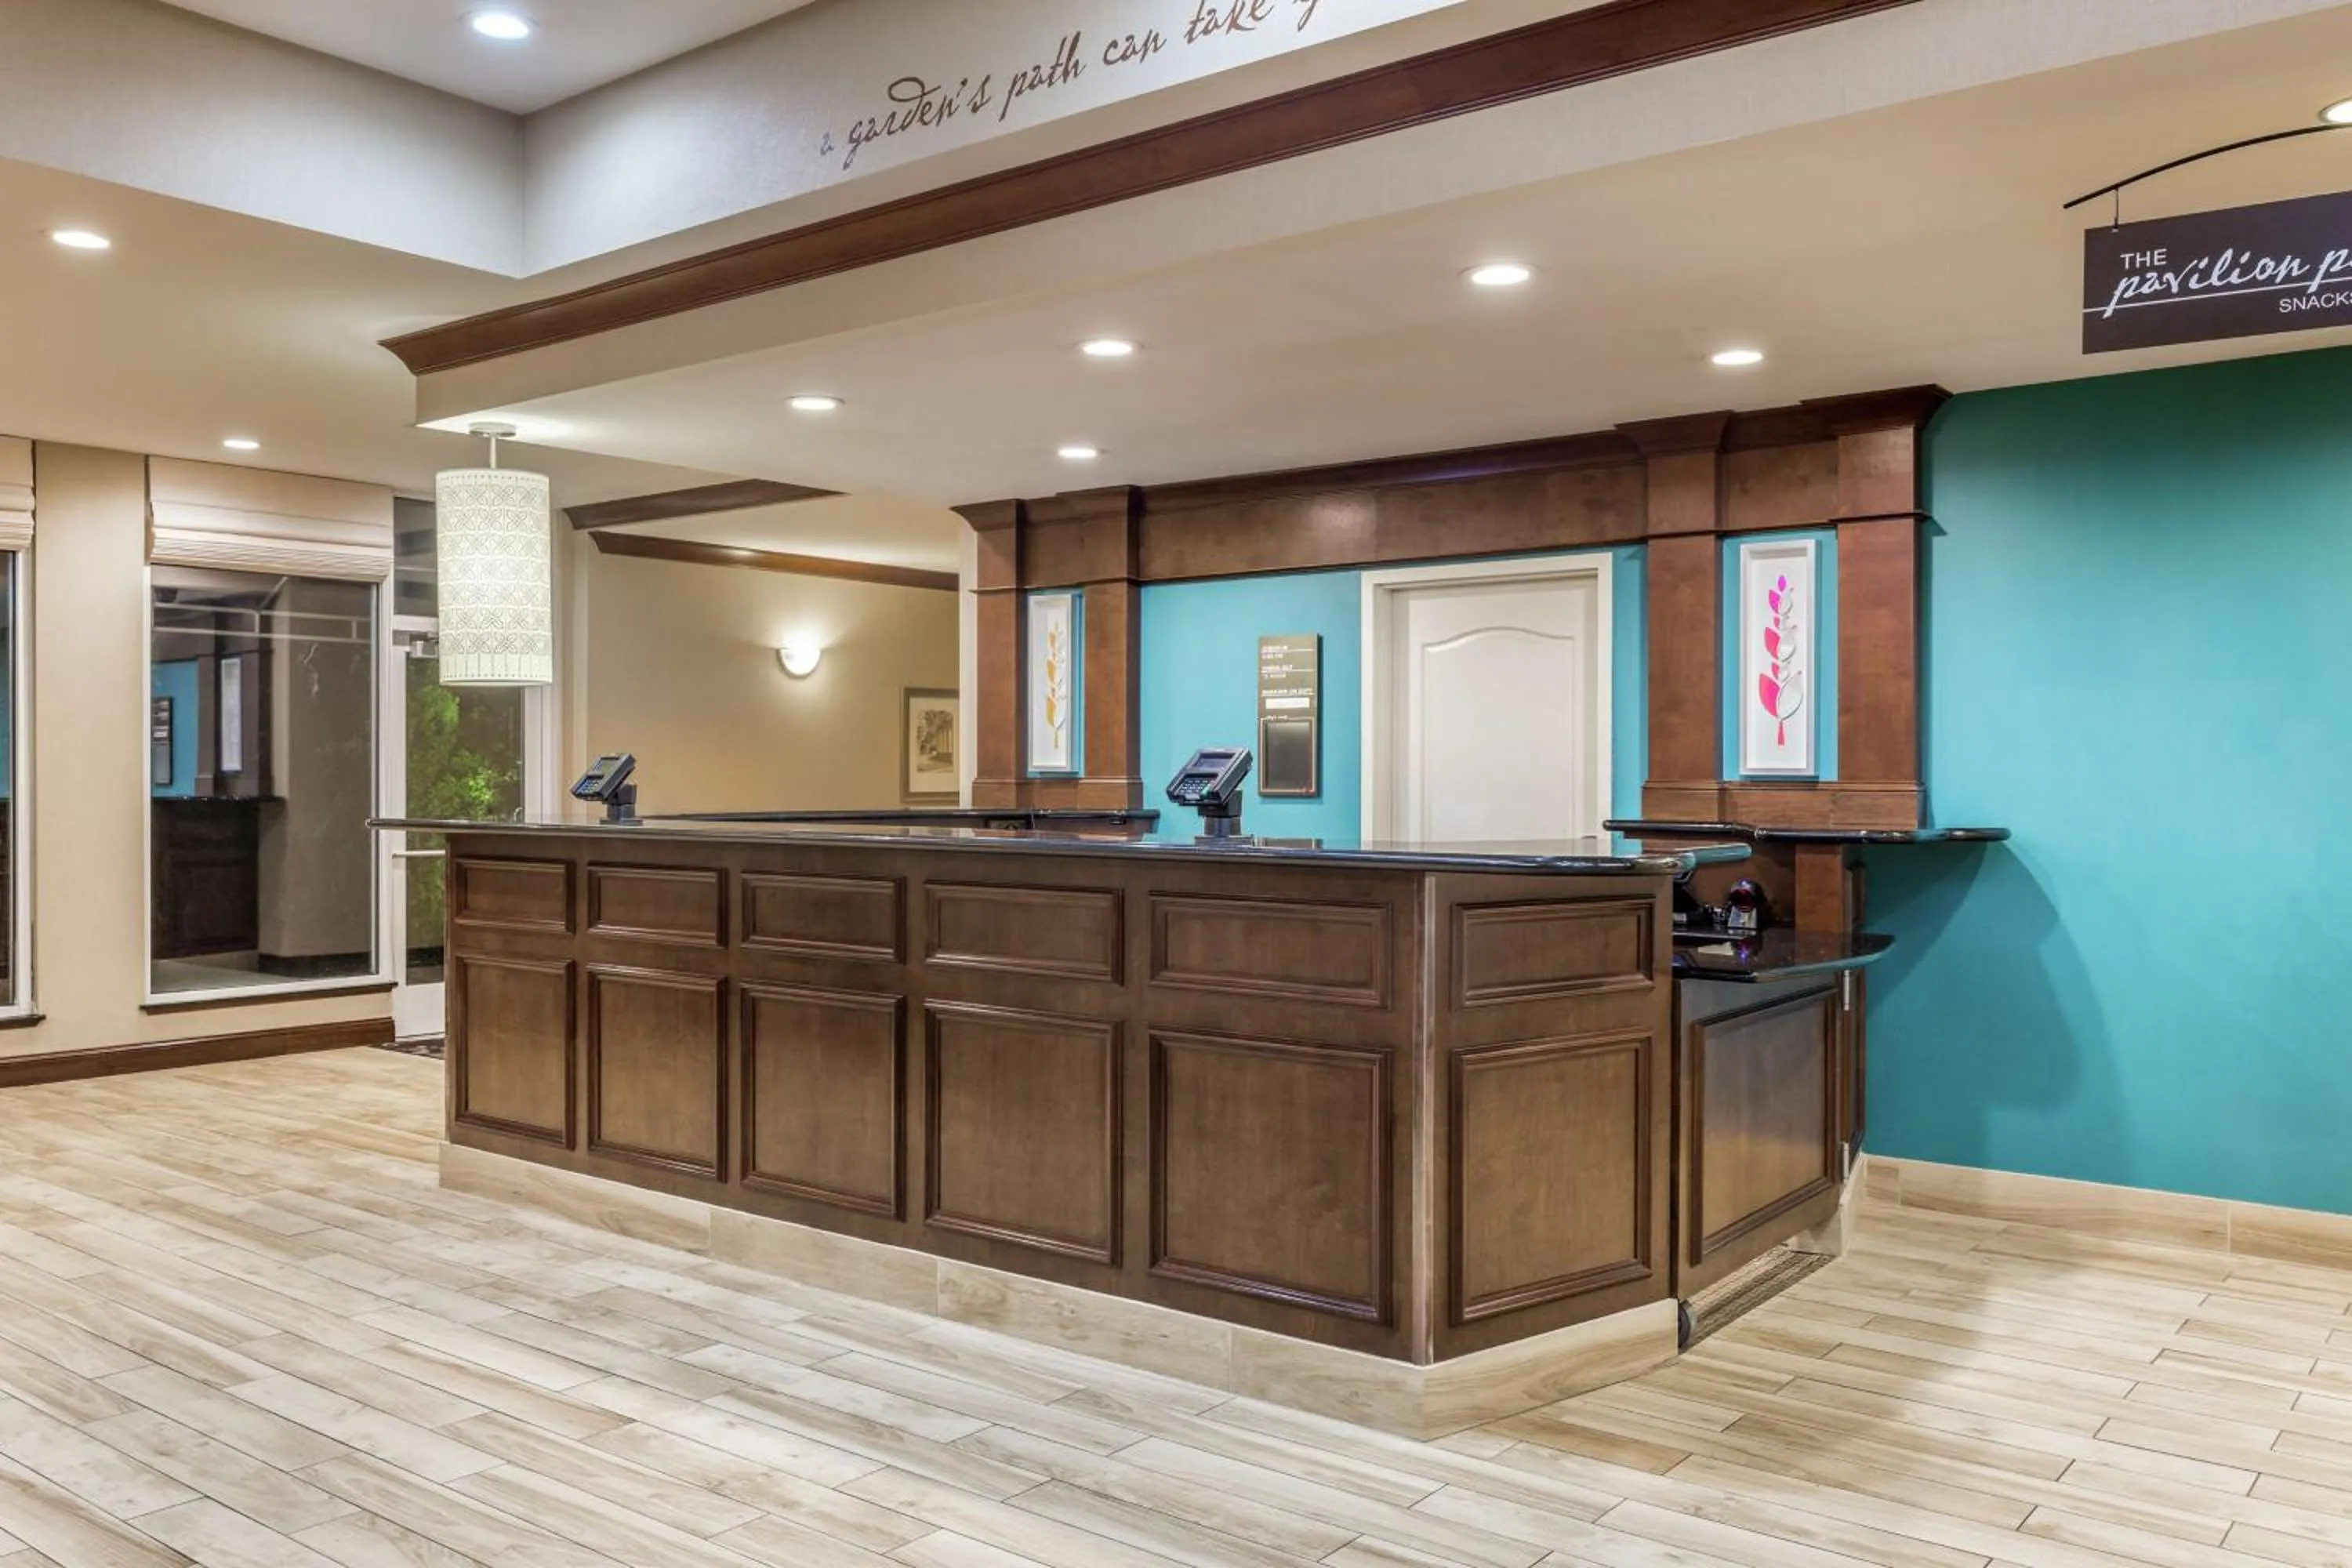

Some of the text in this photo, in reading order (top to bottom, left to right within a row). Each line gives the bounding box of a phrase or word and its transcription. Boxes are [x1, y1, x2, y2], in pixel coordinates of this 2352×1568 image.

[820, 131, 835, 156] a
[842, 75, 993, 170] garden's
[997, 30, 1087, 122] path
[1103, 29, 1167, 65] can
[1184, 0, 1274, 44] take
[2119, 249, 2168, 270] THE
[2102, 248, 2352, 319] pavilion p
[2278, 291, 2352, 313] SNACK
